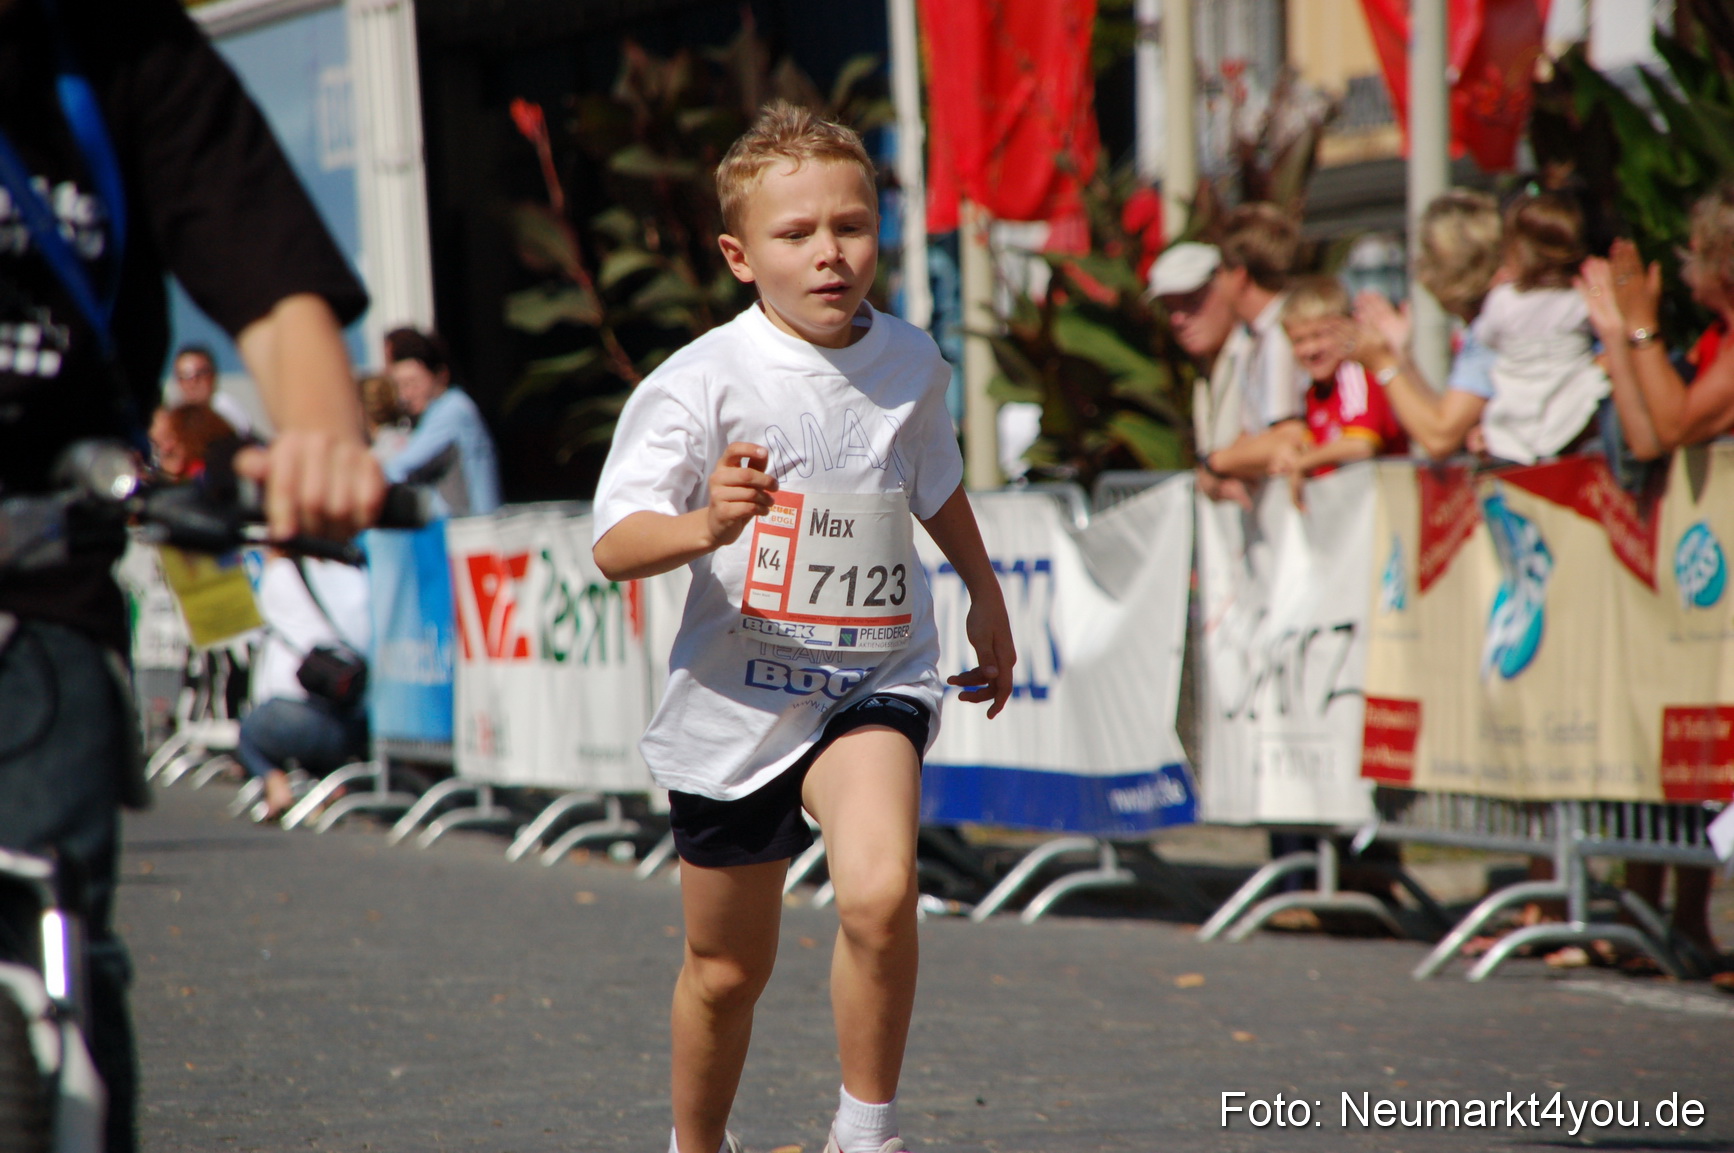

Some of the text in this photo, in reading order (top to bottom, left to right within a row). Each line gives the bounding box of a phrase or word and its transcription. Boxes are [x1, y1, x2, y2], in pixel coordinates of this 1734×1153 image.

[765, 408, 906, 484] MAX
[809, 508, 855, 538] Max
[757, 546, 781, 571] K4
[808, 563, 906, 607] 7123
[743, 617, 816, 638] BOCK
[859, 625, 910, 640] PFLEIDERER
[744, 658, 879, 700] BOC
